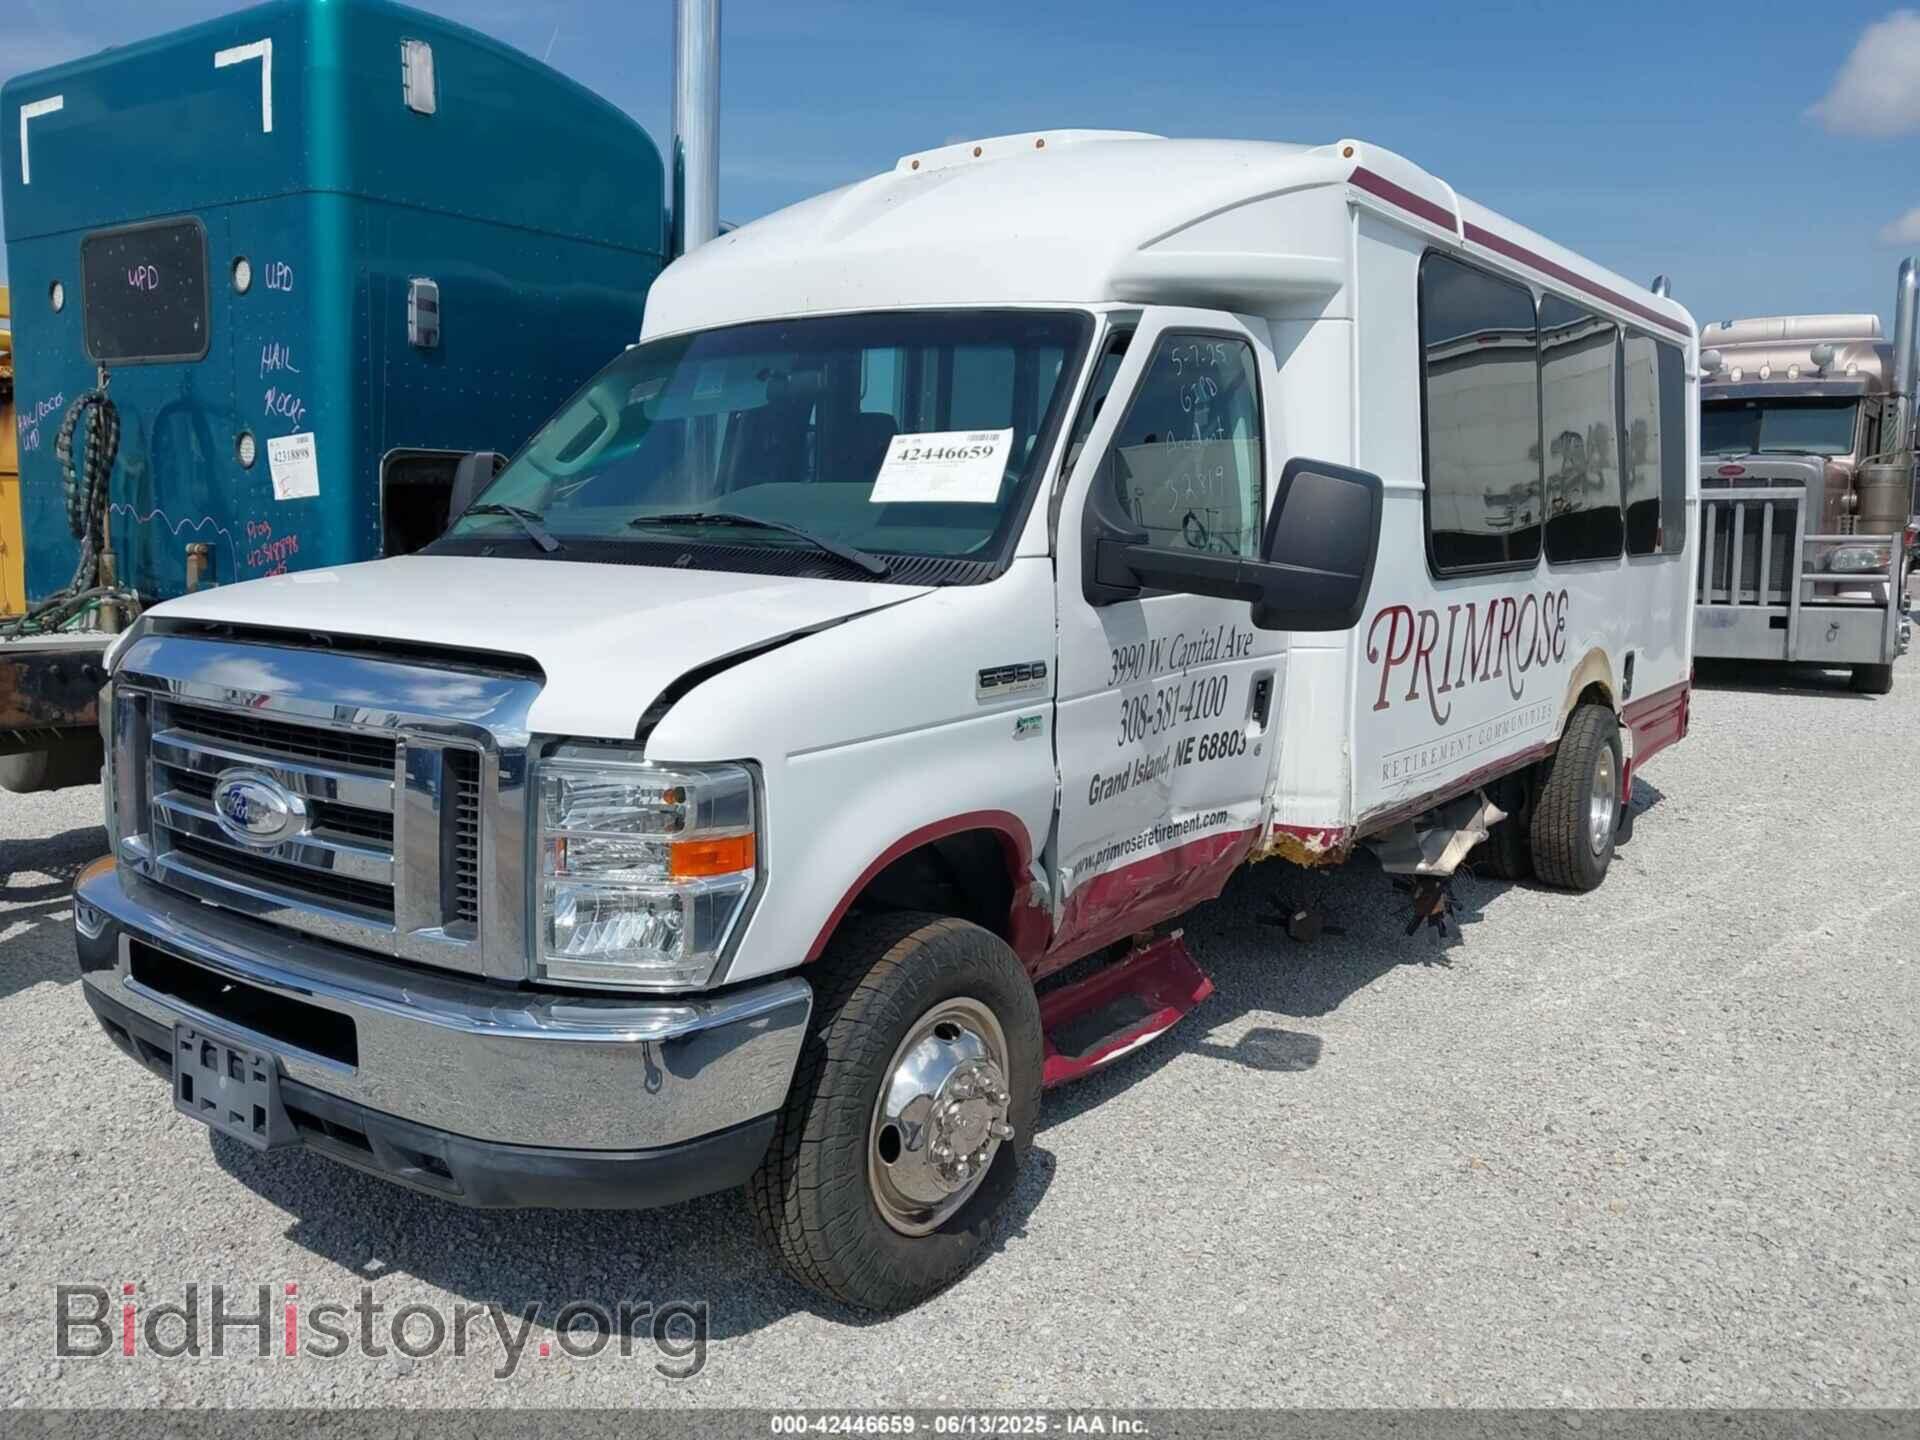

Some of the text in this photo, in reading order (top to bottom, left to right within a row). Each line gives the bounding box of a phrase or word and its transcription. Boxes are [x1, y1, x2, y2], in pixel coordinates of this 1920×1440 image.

[127, 264, 160, 293] UPD
[265, 261, 295, 292] UPD
[259, 342, 301, 380] HAIL
[1171, 343, 1227, 377] 5-7-25
[897, 445, 994, 462] 42446659
[1107, 624, 1254, 687] 3990 W. Capital Ave
[1366, 588, 1569, 726] PRIMROSE
[1117, 674, 1229, 748] 308-381-4100
[1380, 701, 1553, 783] RETIREMENT COMMUNITIES
[1088, 727, 1248, 807] Grand Island, NE 68803
[1072, 809, 1229, 880] www.primroseretirement.com
